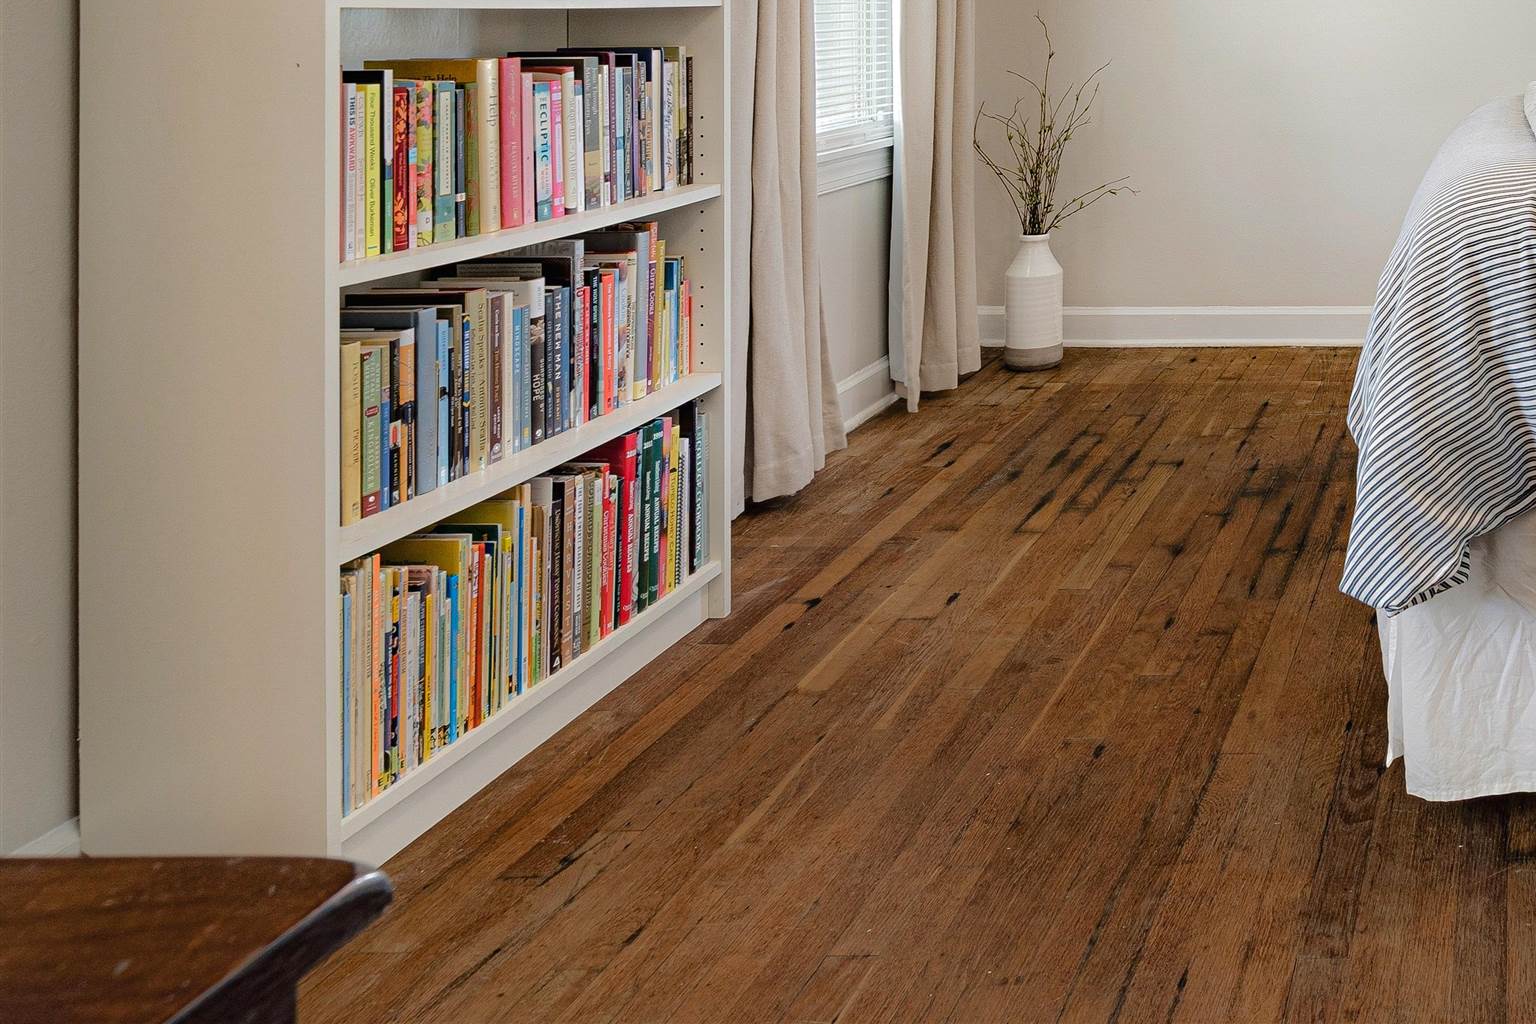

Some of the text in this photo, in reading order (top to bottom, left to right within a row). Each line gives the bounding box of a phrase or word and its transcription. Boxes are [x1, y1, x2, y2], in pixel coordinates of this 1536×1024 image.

[350, 117, 356, 126] IS
[487, 95, 497, 127] Help
[540, 103, 548, 162] ECLIPTIC
[584, 119, 592, 135] Eyes
[554, 293, 562, 319] THE
[476, 303, 486, 369] Scalia Speaks
[532, 374, 540, 401] HOPE
[352, 428, 360, 465] PRAYER
